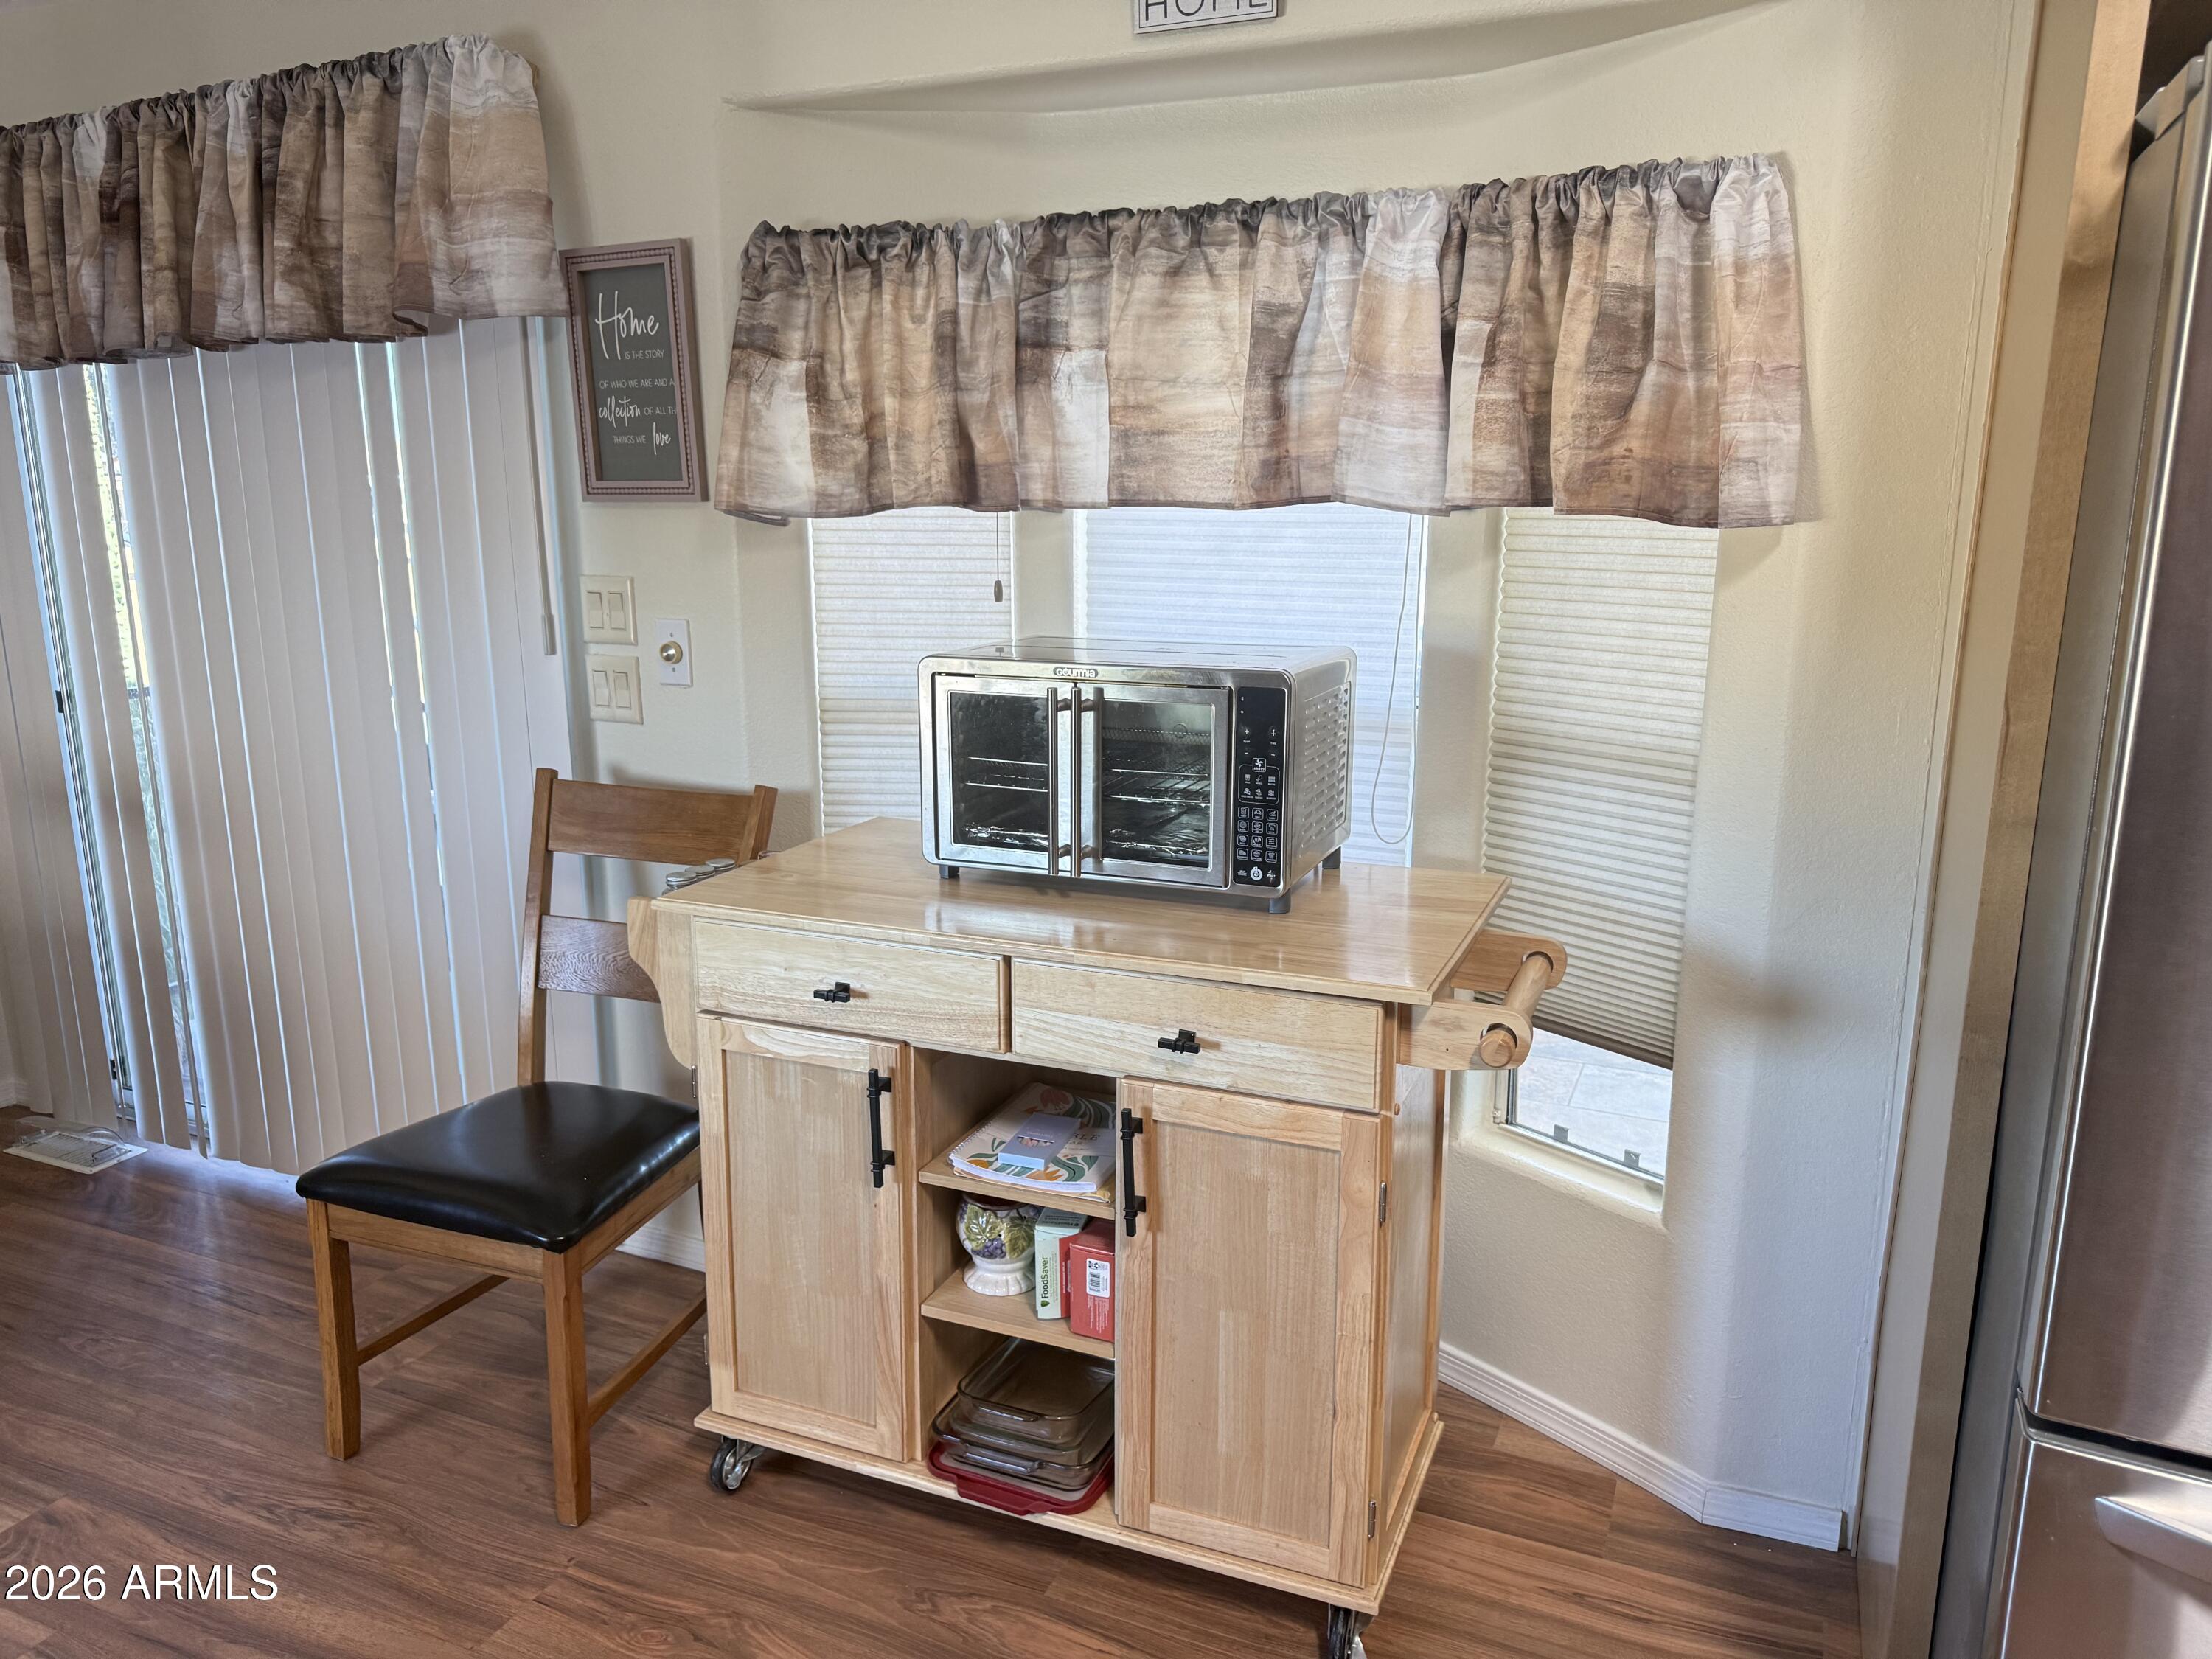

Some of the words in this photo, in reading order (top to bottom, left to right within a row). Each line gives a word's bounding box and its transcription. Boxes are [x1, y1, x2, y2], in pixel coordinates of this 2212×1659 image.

[1145, 0, 1268, 21] HO
[595, 291, 659, 360] Home
[625, 351, 630, 360] IS
[632, 350, 644, 359] THE
[645, 349, 665, 358] STORY
[599, 380, 609, 389] OF
[610, 380, 627, 389] WHO
[628, 379, 639, 388] WE
[640, 379, 653, 387] ARE
[654, 378, 668, 387] AND
[599, 395, 641, 428] collection
[644, 407, 653, 415] OF
[655, 406, 667, 415] ALL
[668, 406, 676, 414] TH
[613, 435, 635, 444] THINGS
[636, 435, 647, 443] WE
[653, 422, 672, 455] love
[1041, 1256, 1049, 1299] FoodSaver
